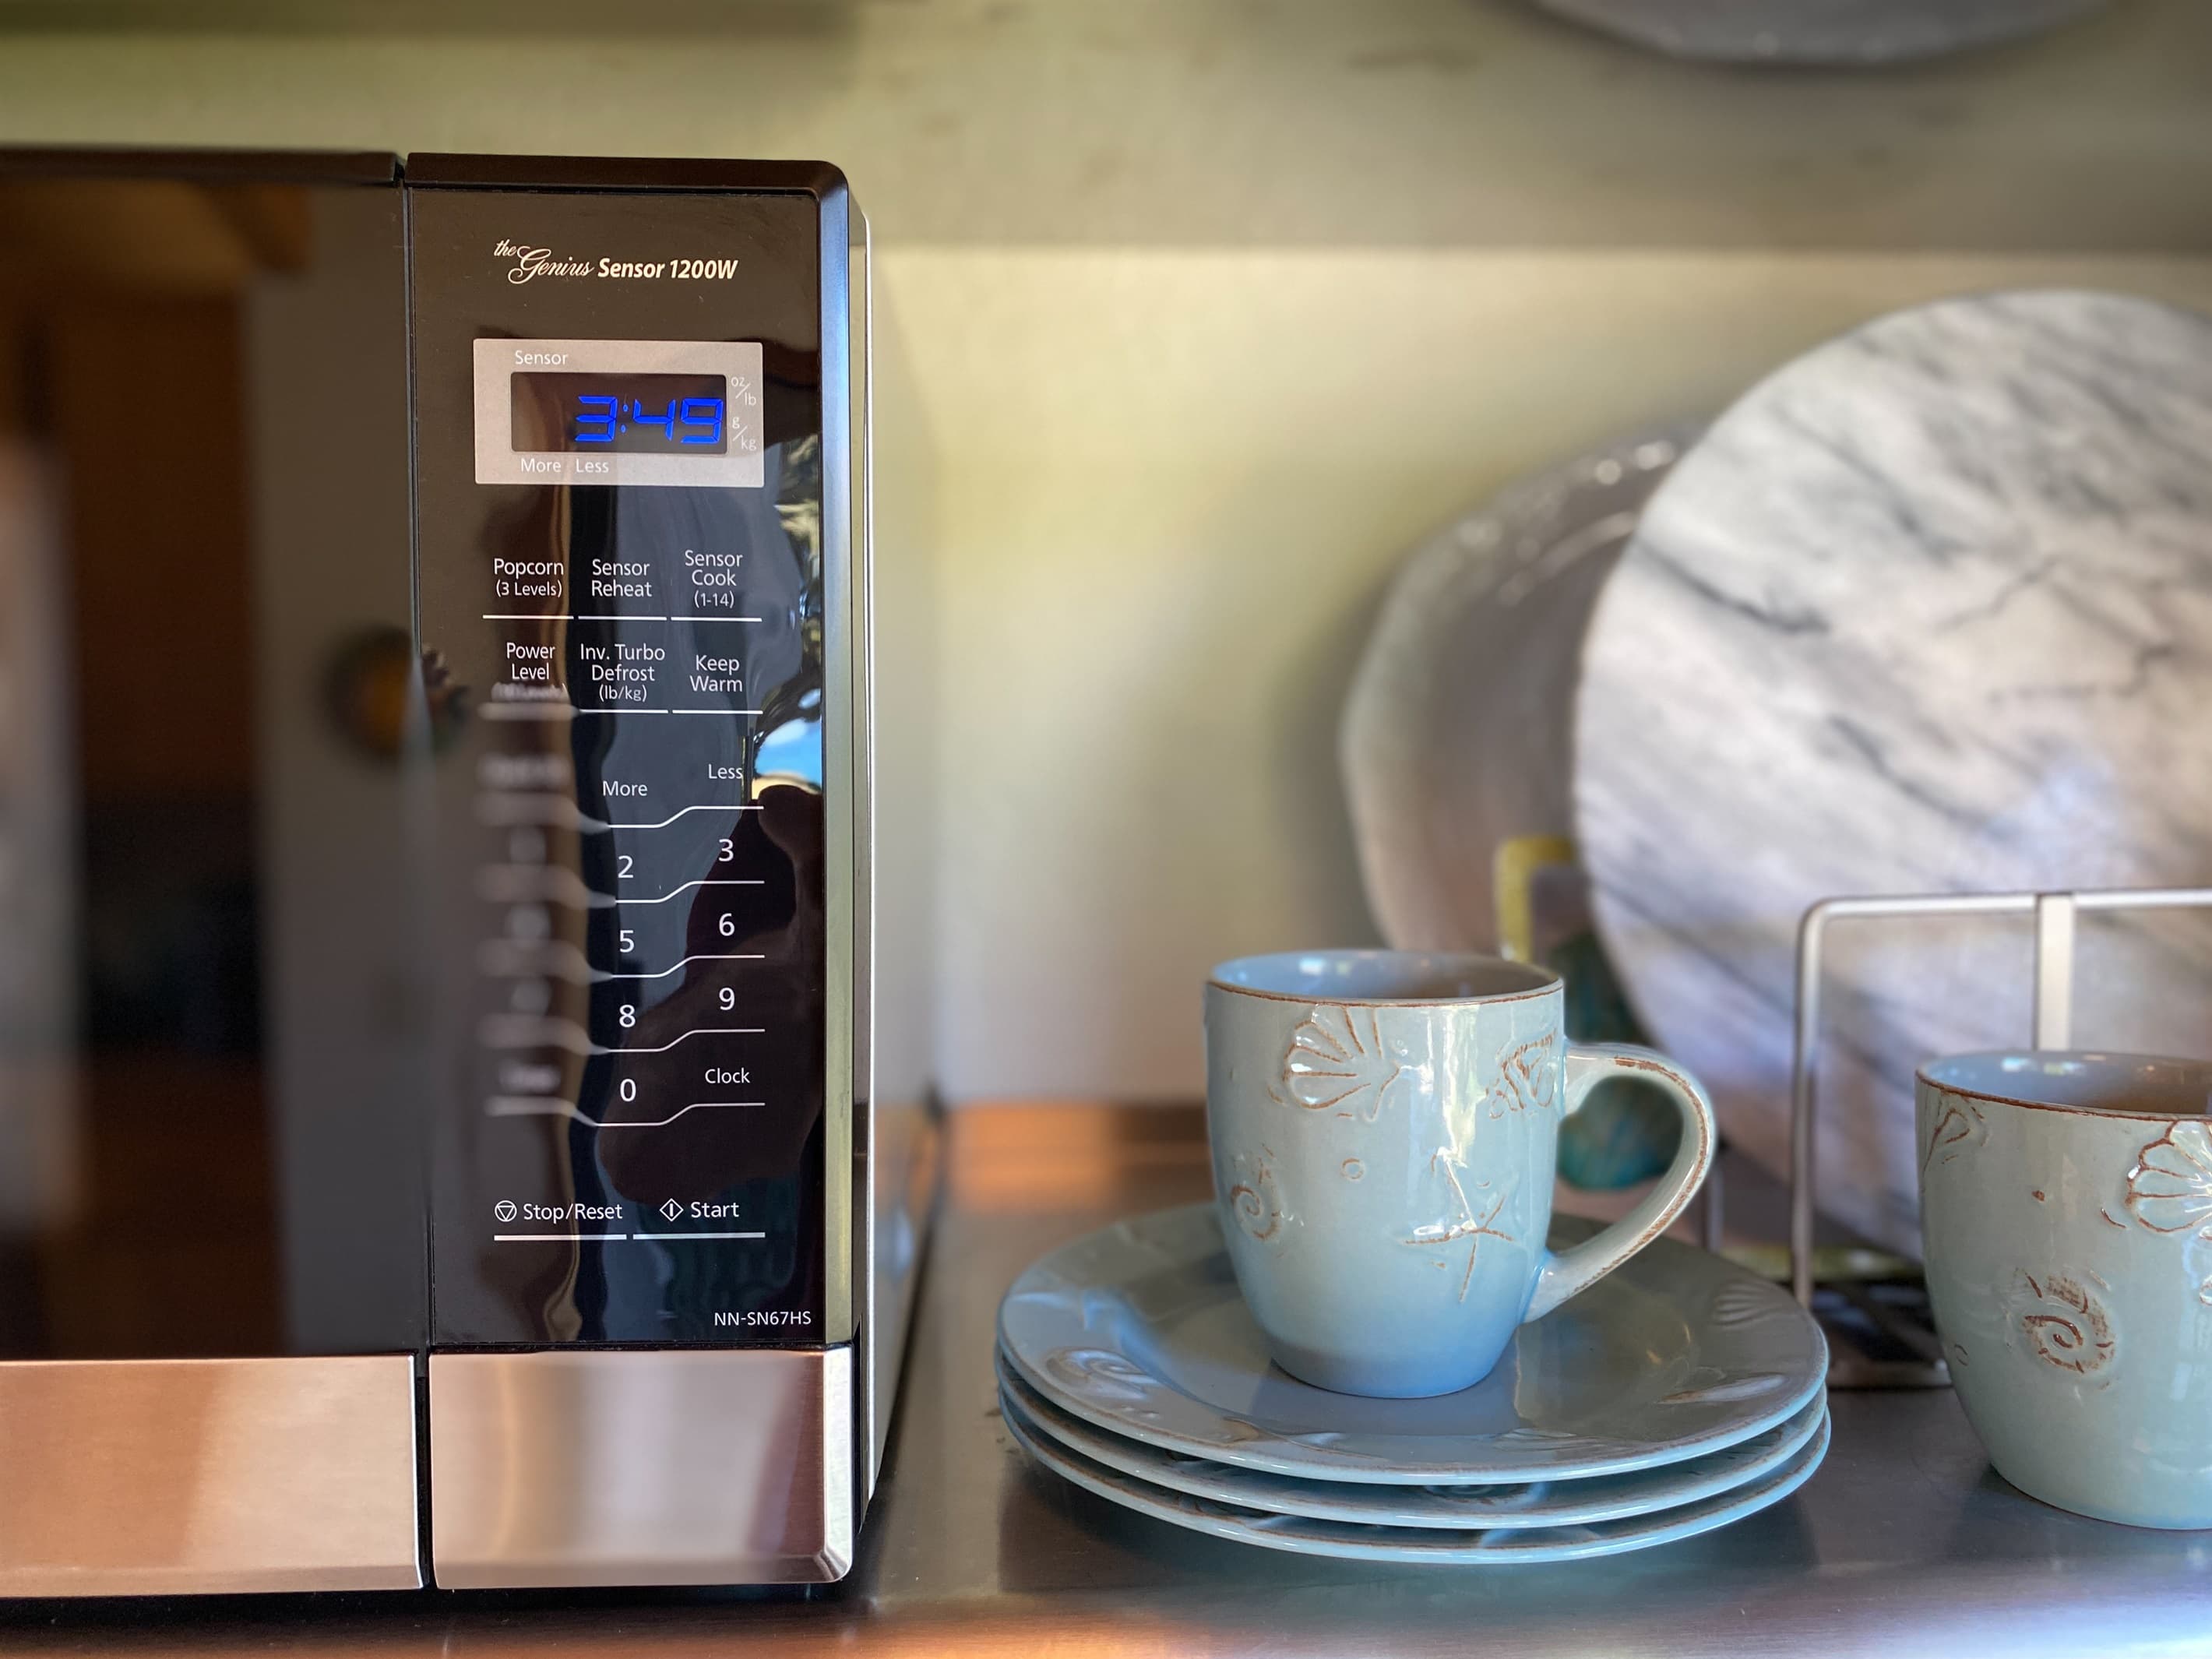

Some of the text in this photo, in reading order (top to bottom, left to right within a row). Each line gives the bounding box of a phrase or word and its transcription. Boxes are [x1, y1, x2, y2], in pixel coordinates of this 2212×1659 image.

[494, 239, 738, 284] the Genius Sensor 1200W
[515, 350, 568, 365] Sensor
[574, 396, 724, 445] 3:49
[520, 459, 609, 474] More Less
[685, 550, 742, 567] Sensor
[494, 558, 564, 579] Popcorn
[592, 559, 650, 576] Sensor
[692, 569, 736, 586] Cook
[495, 579, 562, 597] (3 Levels)
[592, 580, 652, 597] Reheat
[694, 590, 734, 608] (1-14)
[506, 643, 555, 659] Power
[580, 644, 665, 660] Inv. Turbo
[512, 664, 550, 680] Level
[592, 664, 655, 682] Defrost
[696, 655, 740, 675] Keep
[690, 675, 742, 692] Warm
[599, 685, 646, 702] (lb/kg)
[709, 764, 743, 780] Less
[602, 781, 648, 797] More
[718, 838, 734, 861] 3
[618, 855, 634, 879] 2
[719, 913, 735, 936] 6
[620, 929, 635, 953] 5
[719, 988, 735, 1010] 9
[619, 1004, 636, 1027] 8
[705, 1068, 750, 1084] Clock
[620, 1079, 636, 1102] 0
[523, 1203, 623, 1224] Stop/Reset
[690, 1201, 739, 1218] Start
[714, 1311, 812, 1326] NN-SN67HS
